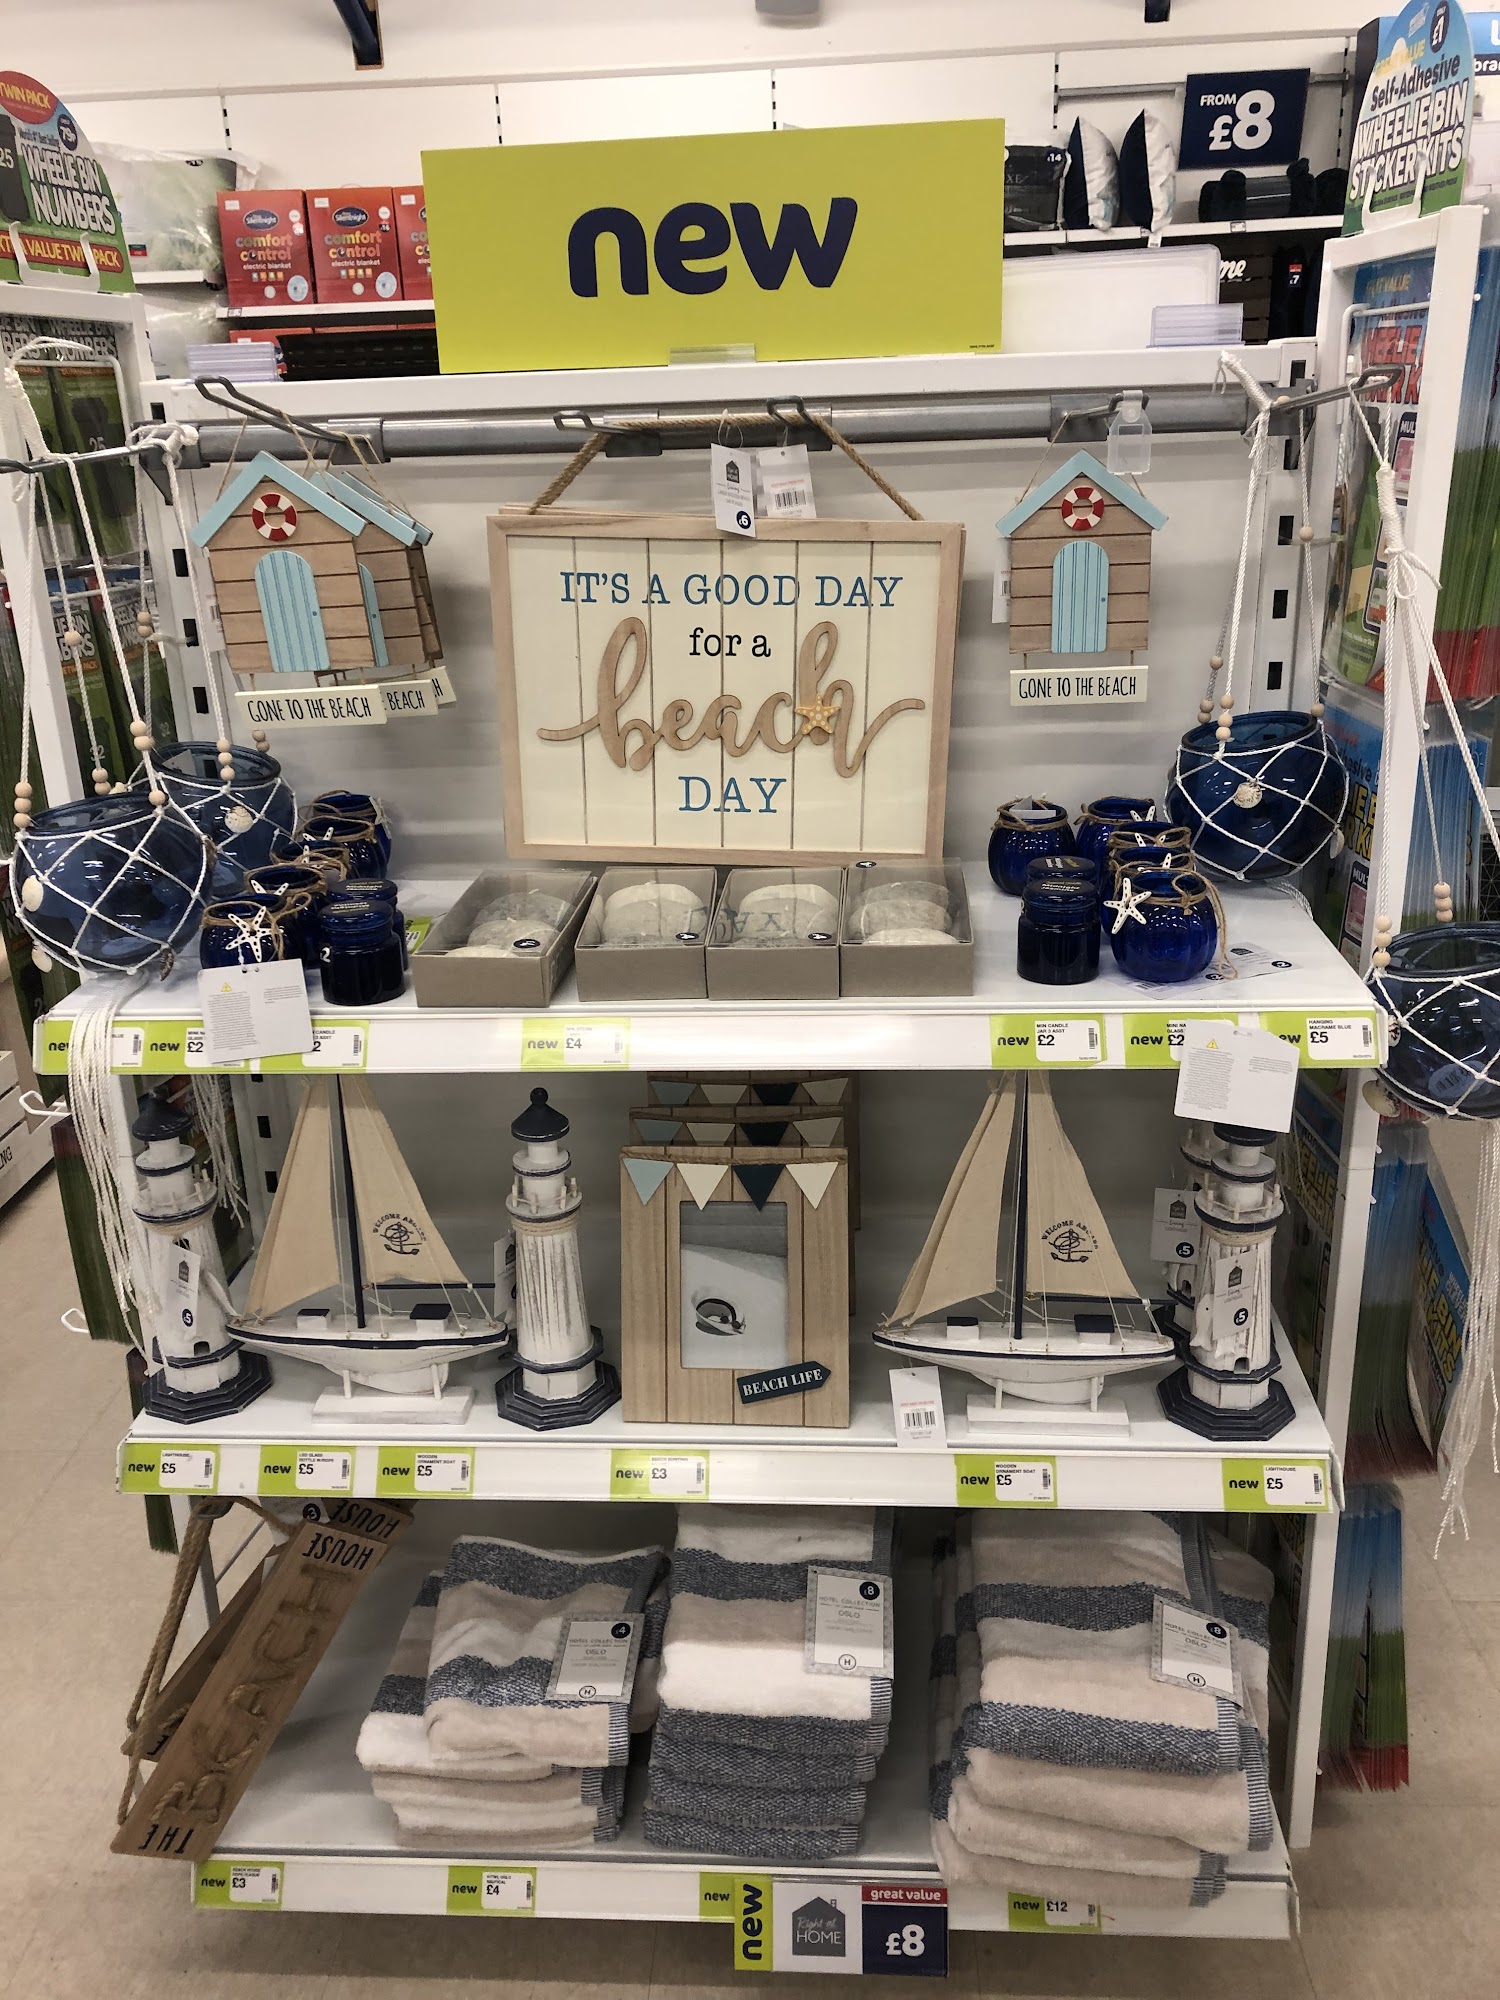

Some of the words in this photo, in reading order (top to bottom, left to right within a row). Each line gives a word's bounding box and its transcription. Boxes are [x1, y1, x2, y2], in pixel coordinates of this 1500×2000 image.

[1370, 54, 1461, 111] Self-Adhesive
[26, 89, 51, 109] PACK
[1200, 94, 1237, 108] FROM
[1208, 89, 1276, 151] £8
[1359, 93, 1432, 160] WHEELIE
[1431, 78, 1469, 135] BIN
[21, 142, 80, 190] WHEELIE
[76, 155, 103, 194] BIN
[1349, 141, 1418, 201] STCKER
[1418, 126, 1466, 178] KITS
[30, 181, 116, 235] NUMBERS
[235, 234, 293, 248] comfort
[324, 230, 382, 245] comfort
[26, 239, 64, 259] VALUE
[61, 244, 86, 263] TWI
[94, 248, 121, 268] PACK
[328, 243, 381, 259] control
[567, 196, 858, 298] new
[240, 247, 292, 262] control
[267, 262, 292, 270] blanket
[331, 259, 356, 267] electric
[356, 258, 381, 266] blanket
[560, 572, 631, 604] IT'S
[641, 574, 671, 605] A
[683, 574, 801, 606] GOOD
[814, 576, 904, 608] DAY
[688, 627, 743, 657] for
[751, 634, 771, 658] a
[1019, 678, 1052, 699] GONE
[1057, 677, 1071, 697] TO
[1075, 676, 1094, 696] THE
[1099, 676, 1137, 697] BEACH
[386, 689, 426, 711] BEACH
[536, 616, 926, 779] beach
[247, 698, 286, 723] GONE
[286, 698, 304, 720] TO
[304, 697, 329, 719] THE
[328, 696, 372, 719] BEACH
[678, 775, 788, 814] DAY
[565, 1037, 583, 1049] £4
[997, 1036, 1030, 1046] new
[1037, 1034, 1055, 1046] £2
[1130, 1035, 1163, 1046] new
[1167, 1034, 1185, 1046] £2
[1310, 1031, 1329, 1044] £5
[149, 1042, 180, 1052] new
[187, 1041, 204, 1053] £2
[527, 1040, 559, 1049] new
[372, 1213, 401, 1234] WELCOME
[1041, 1220, 1074, 1240] WELCOME
[742, 1376, 789, 1397] BEACH
[791, 1368, 823, 1386] LIFE
[128, 1463, 155, 1473] new
[161, 1462, 176, 1474] £5
[263, 1464, 292, 1474] new
[298, 1463, 314, 1475] £5
[382, 1466, 410, 1476] new
[416, 1464, 433, 1477] £5
[615, 1469, 645, 1479] new
[651, 1467, 668, 1479] £3
[960, 1475, 990, 1485] new
[996, 1474, 1013, 1486] £5
[1228, 1479, 1259, 1489] new
[1266, 1477, 1284, 1490] £5
[328, 1499, 401, 1539] HOUSE
[302, 1532, 374, 1571] HOUSE
[840, 1597, 881, 1608] COLLECTION
[837, 1610, 860, 1619] OSLO
[1184, 1637, 1208, 1649] OSLO
[844, 1658, 851, 1666] H
[1192, 1676, 1200, 1684] H
[138, 1823, 195, 1855] THE
[201, 1878, 226, 1888] new
[232, 1877, 246, 1889] £3
[451, 1884, 478, 1894] new
[486, 1884, 500, 1896] £4
[703, 1891, 730, 1902] new
[870, 1888, 904, 1901] great
[906, 1889, 942, 1901] value
[1013, 1901, 1040, 1910] new
[1046, 1901, 1068, 1912] £12
[741, 1883, 763, 1961] new
[797, 1916, 823, 1932] Right
[825, 1917, 838, 1928] at
[796, 1929, 842, 1945] HOME
[885, 1923, 926, 1958] £8
